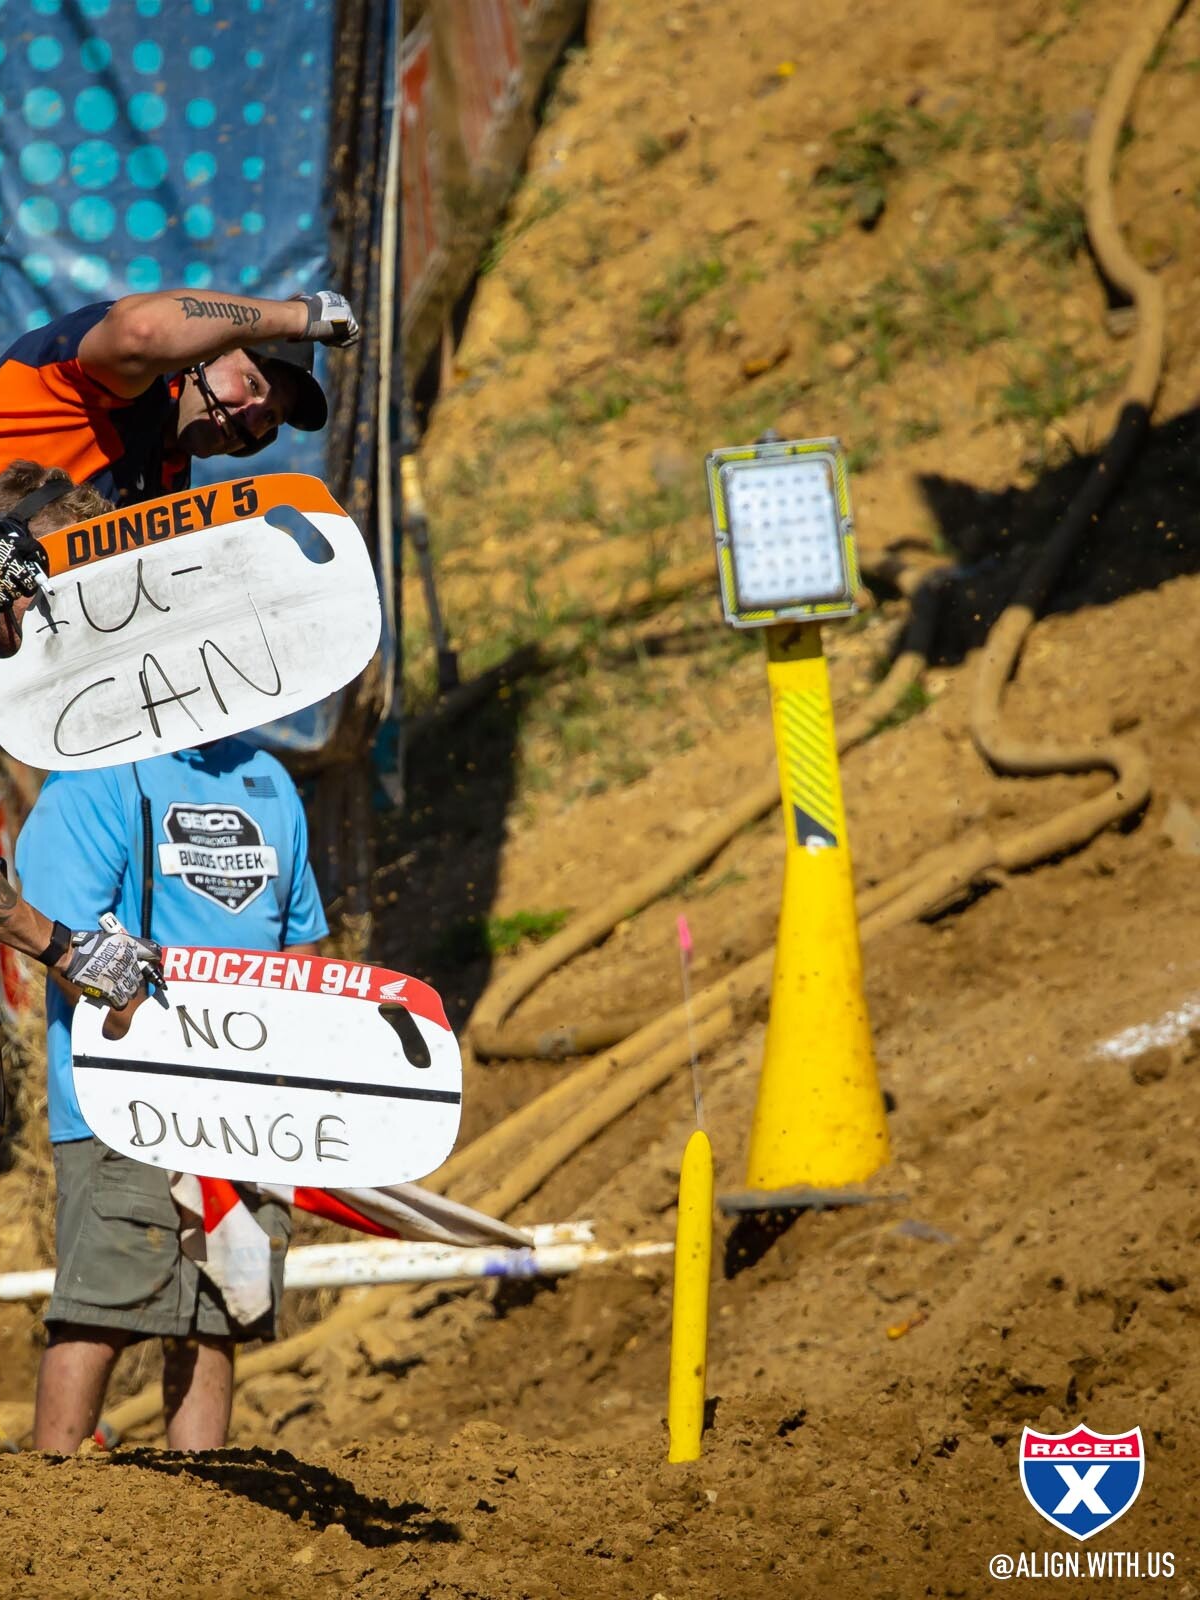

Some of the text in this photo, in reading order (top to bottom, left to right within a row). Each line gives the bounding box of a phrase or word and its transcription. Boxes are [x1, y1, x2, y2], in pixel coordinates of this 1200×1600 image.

[174, 296, 262, 334] Dungey
[67, 479, 259, 565] DUNGEY 5
[53, 592, 282, 757] CAN
[176, 812, 241, 832] GEICO
[217, 851, 265, 871] CREEK
[164, 948, 312, 991] ROCZEN
[320, 964, 371, 997] 94
[379, 994, 409, 1002] HONDA
[176, 1004, 268, 1052] NO
[128, 1100, 350, 1162] DUNGE
